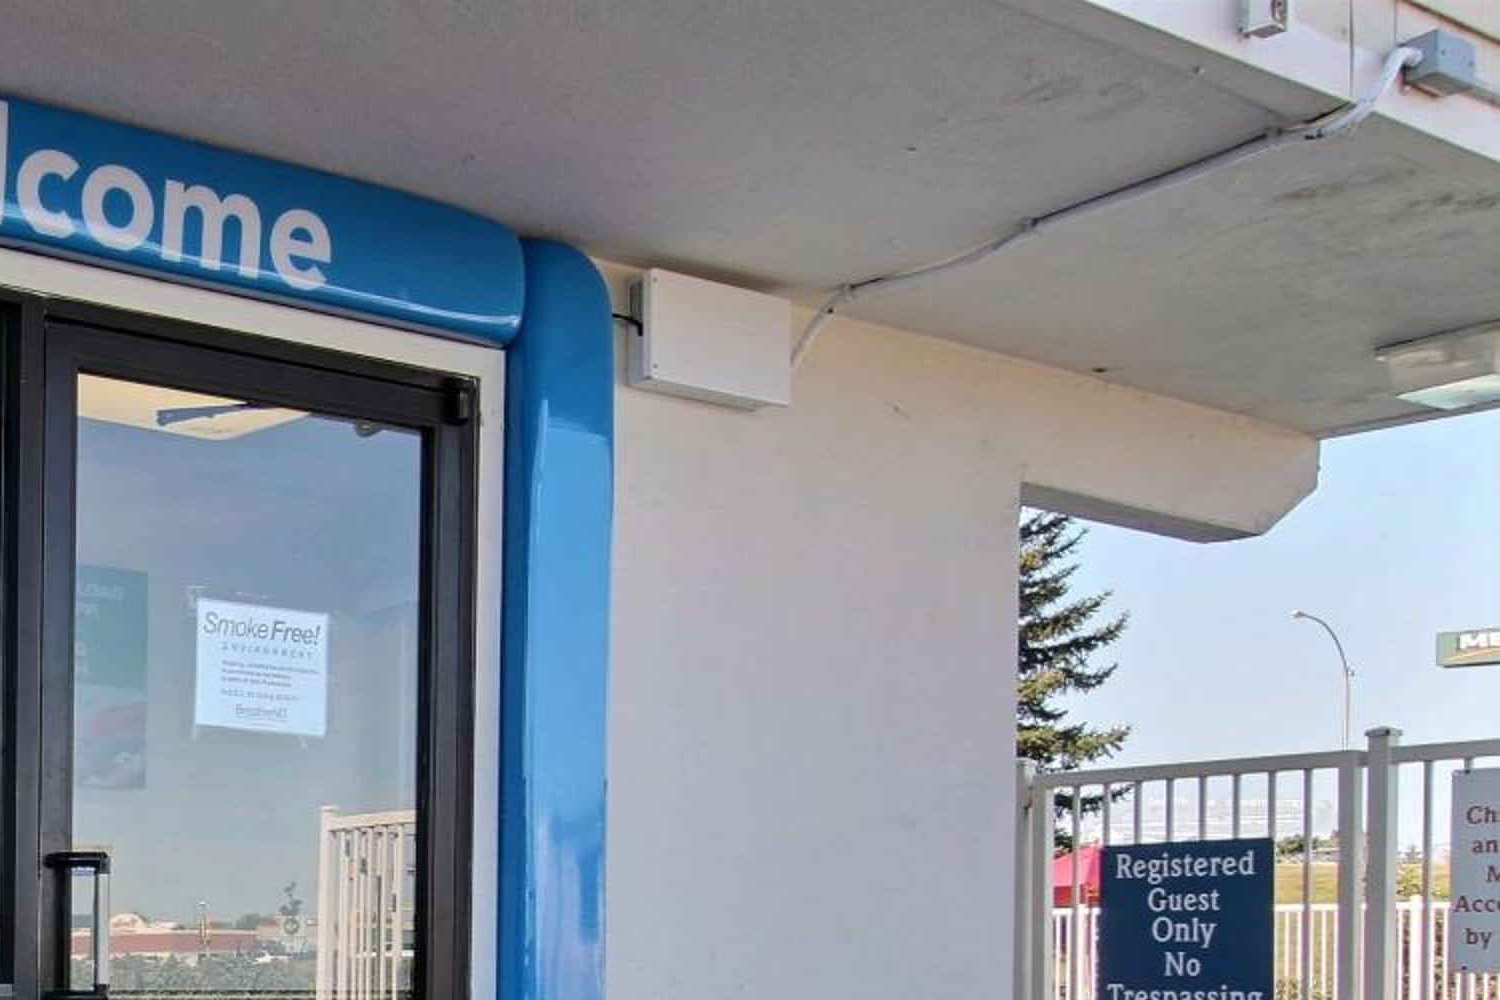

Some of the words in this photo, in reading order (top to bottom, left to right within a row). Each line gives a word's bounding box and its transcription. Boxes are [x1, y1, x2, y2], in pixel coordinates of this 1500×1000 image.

[1115, 850, 1256, 885] Registered
[1147, 887, 1221, 912] Guest
[1152, 916, 1217, 948] Only
[1466, 928, 1492, 950] by
[1164, 951, 1201, 977] No
